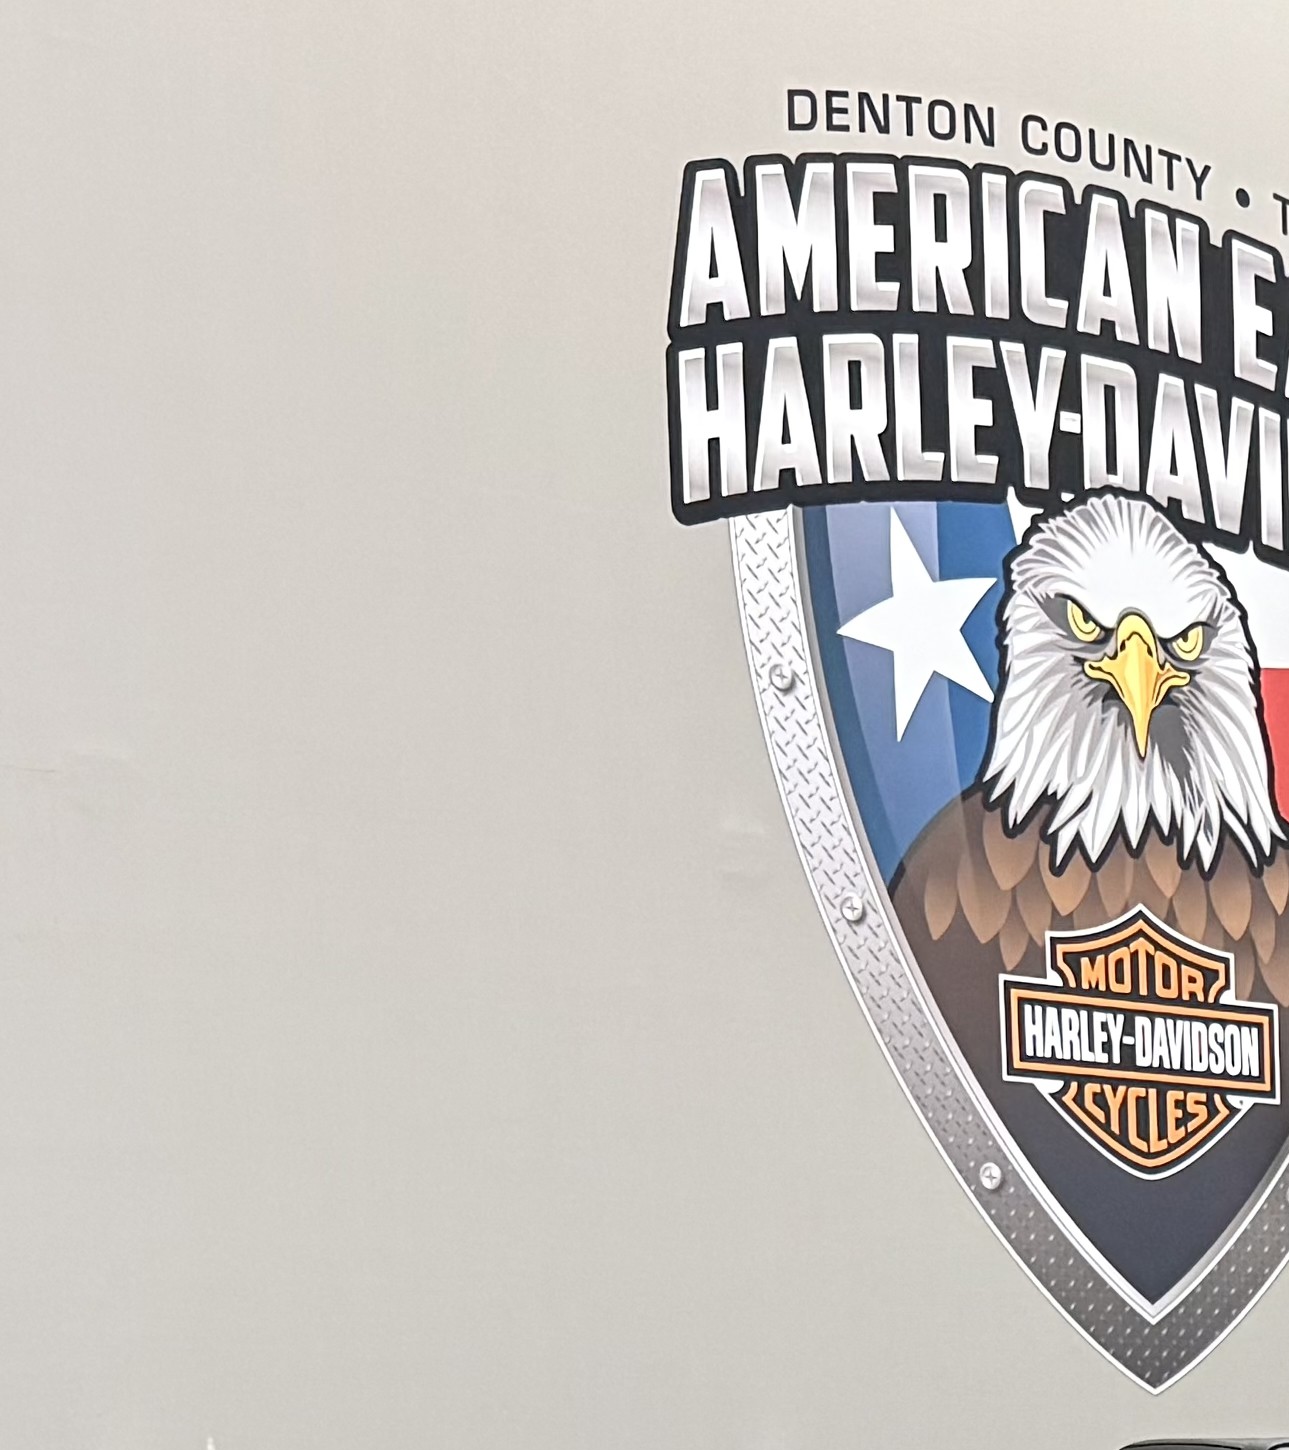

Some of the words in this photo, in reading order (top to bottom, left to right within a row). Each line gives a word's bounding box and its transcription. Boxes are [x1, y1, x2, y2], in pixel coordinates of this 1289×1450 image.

[787, 88, 996, 148] DENTON
[1021, 115, 1213, 202] COUNTY
[677, 160, 1202, 364] AMERICAN
[1080, 936, 1205, 1003] MOTOR
[1023, 1004, 1260, 1077] HARLEY-DAVIDSON
[1084, 1085, 1208, 1154] CYCLES
